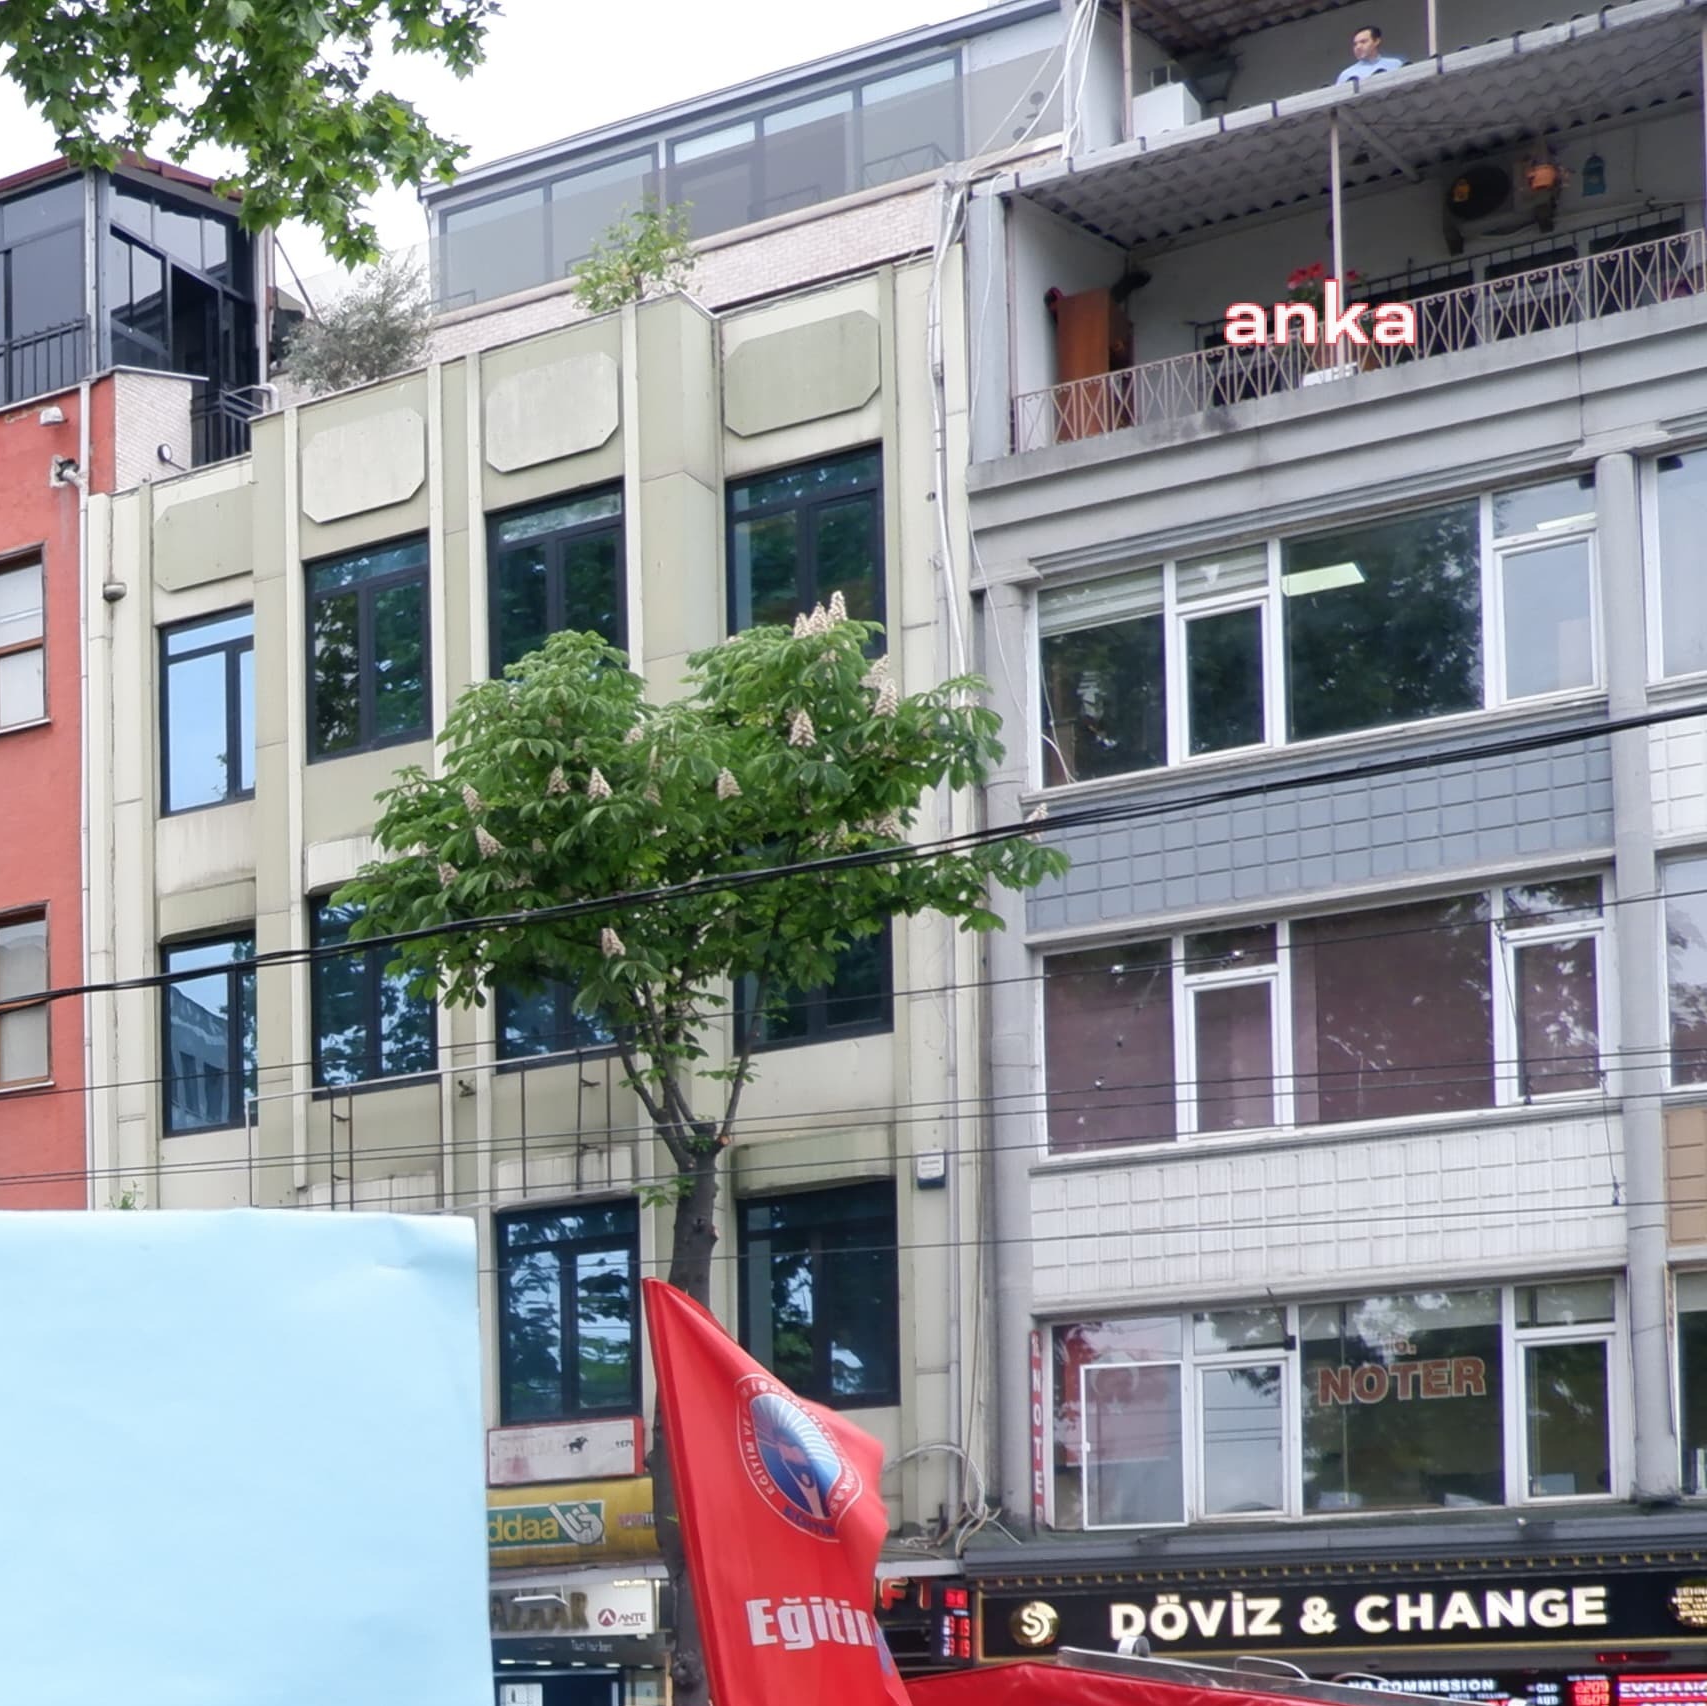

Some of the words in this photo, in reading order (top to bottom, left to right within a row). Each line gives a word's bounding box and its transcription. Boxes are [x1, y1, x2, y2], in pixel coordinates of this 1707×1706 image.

[1317, 1356, 1488, 1406] NOTER
[1110, 1591, 1282, 1641] DÖVİZ
[1299, 1595, 1338, 1636] &
[1354, 1586, 1609, 1633] CHANGE
